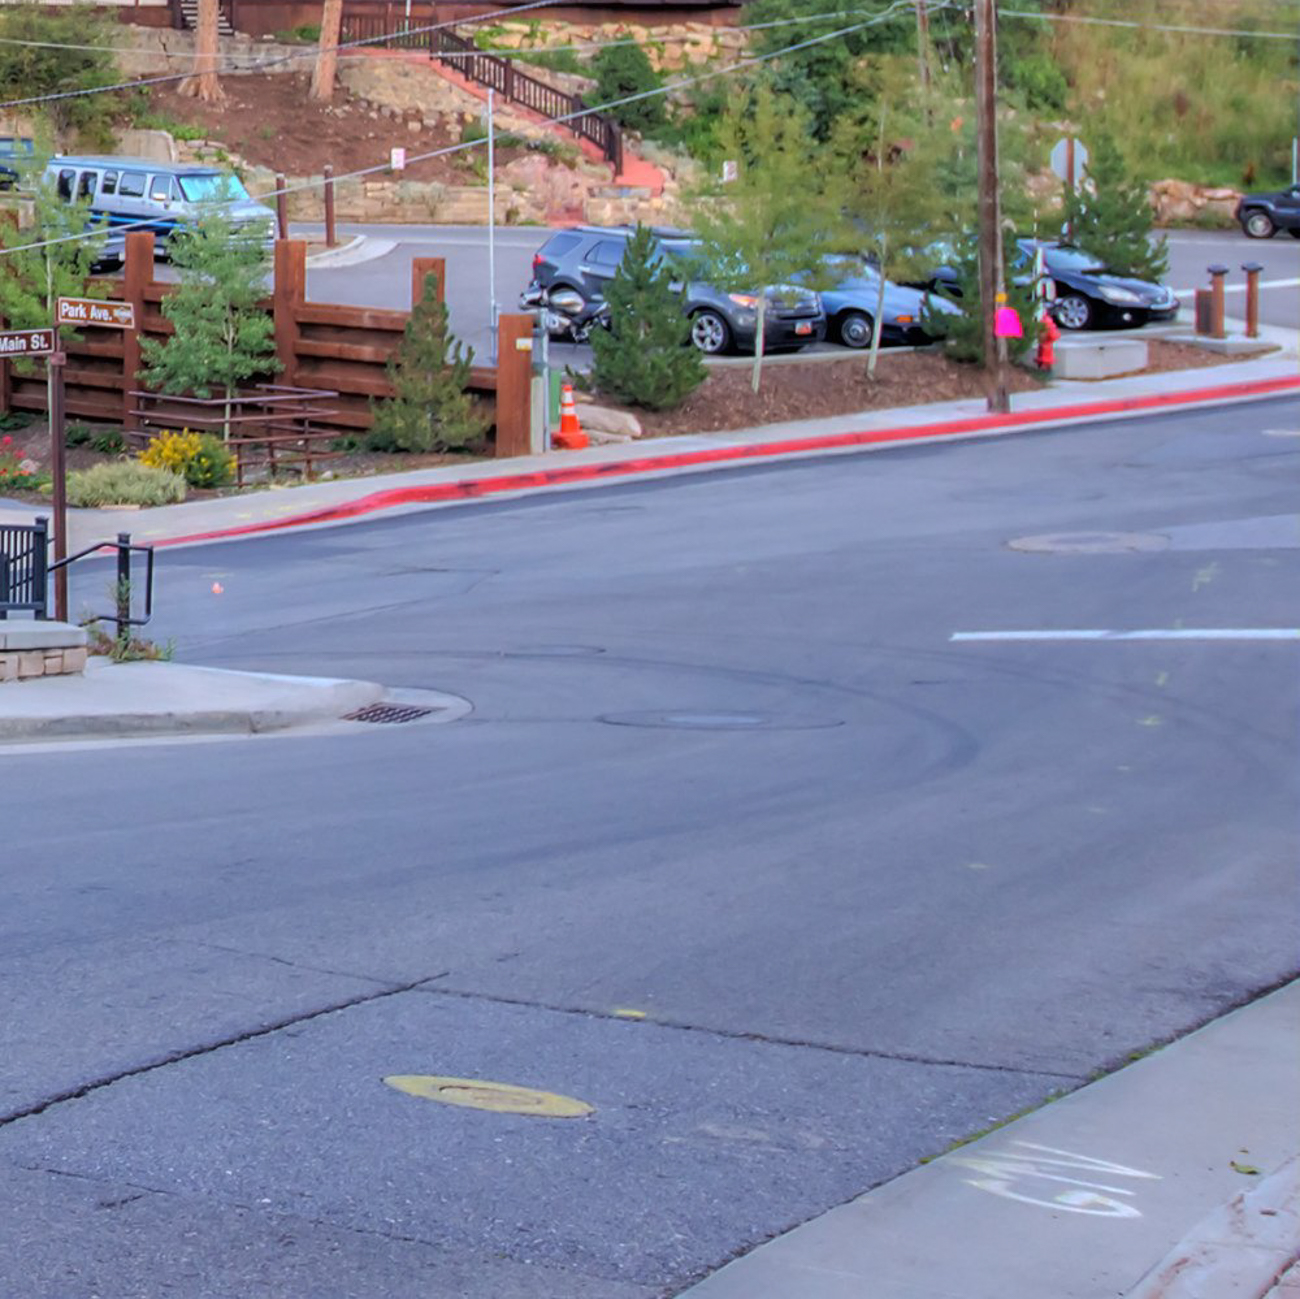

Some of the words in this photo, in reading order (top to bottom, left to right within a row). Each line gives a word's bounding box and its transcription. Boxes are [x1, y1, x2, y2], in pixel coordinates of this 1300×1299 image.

[61, 302, 87, 319] Park
[90, 305, 112, 320] Ave.
[30, 334, 49, 350] St.
